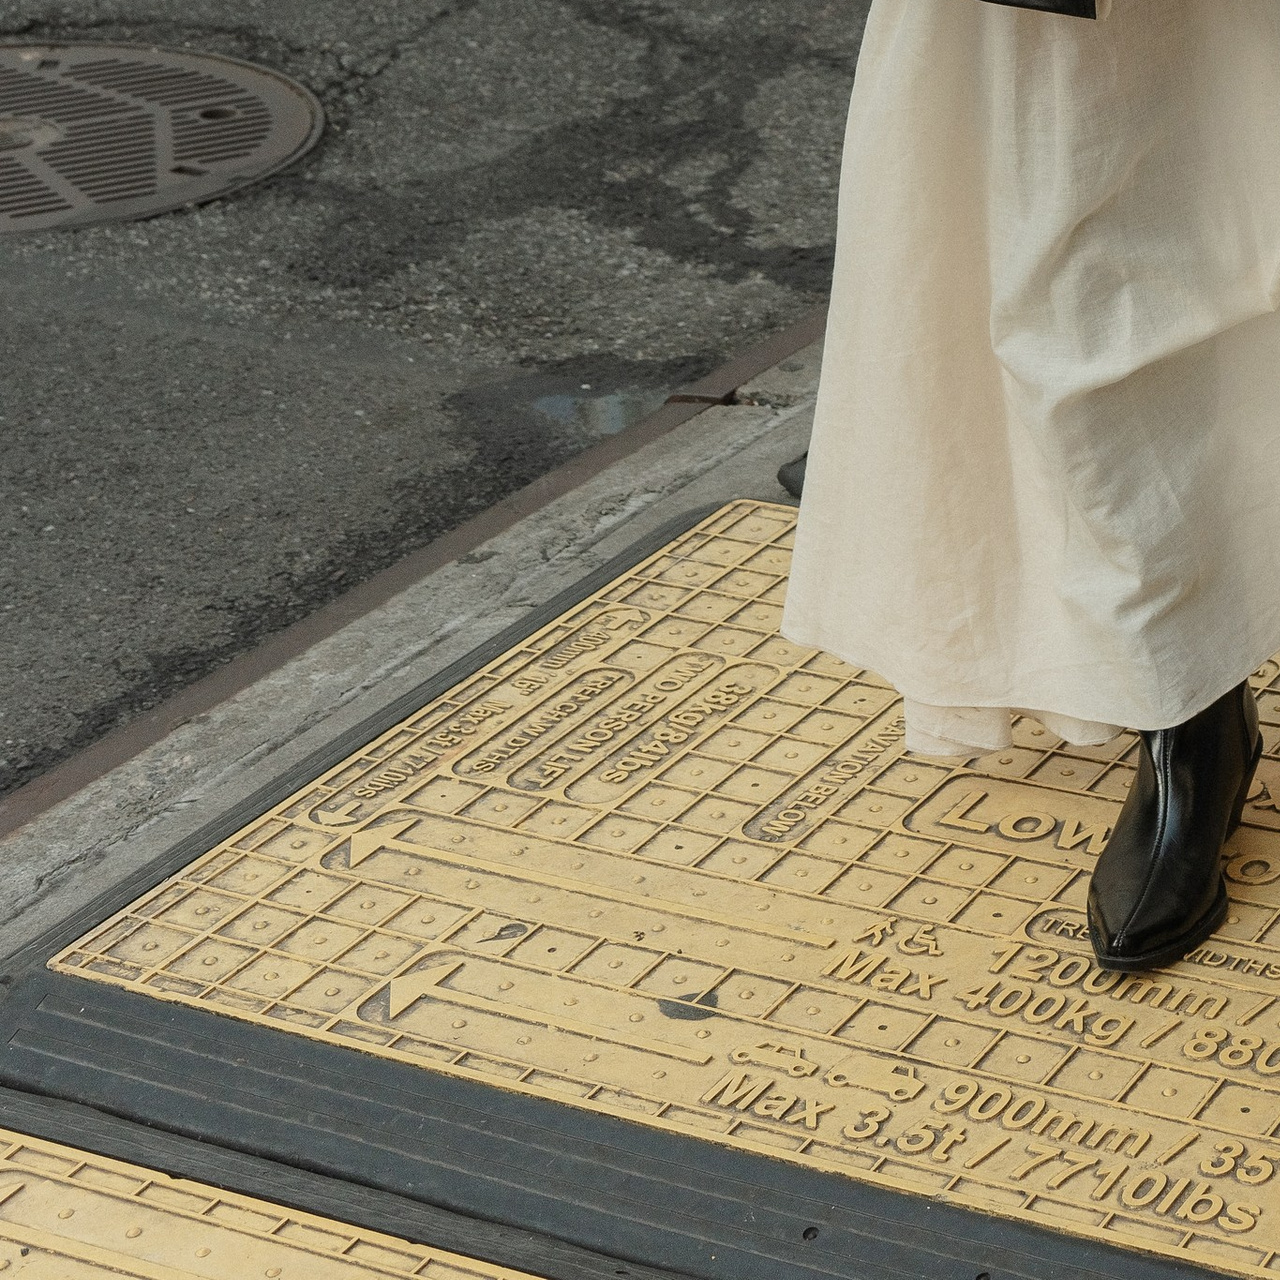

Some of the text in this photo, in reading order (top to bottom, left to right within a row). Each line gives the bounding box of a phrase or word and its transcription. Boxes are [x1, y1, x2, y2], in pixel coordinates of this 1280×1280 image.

[465, 698, 513, 725] Max
[526, 660, 715, 788] TWO PERSON LIFT
[762, 716, 905, 837] CAVATION BELOW
[1042, 917, 1090, 942] TRE
[822, 950, 948, 1001] Max
[957, 977, 1136, 1045] 400kg
[989, 946, 1227, 1020] 1200mm
[702, 1073, 833, 1131] Max
[843, 1103, 969, 1164] 3.5t
[1010, 1143, 1263, 1234] 7710lbs
[933, 1076, 1150, 1158] 900mm
